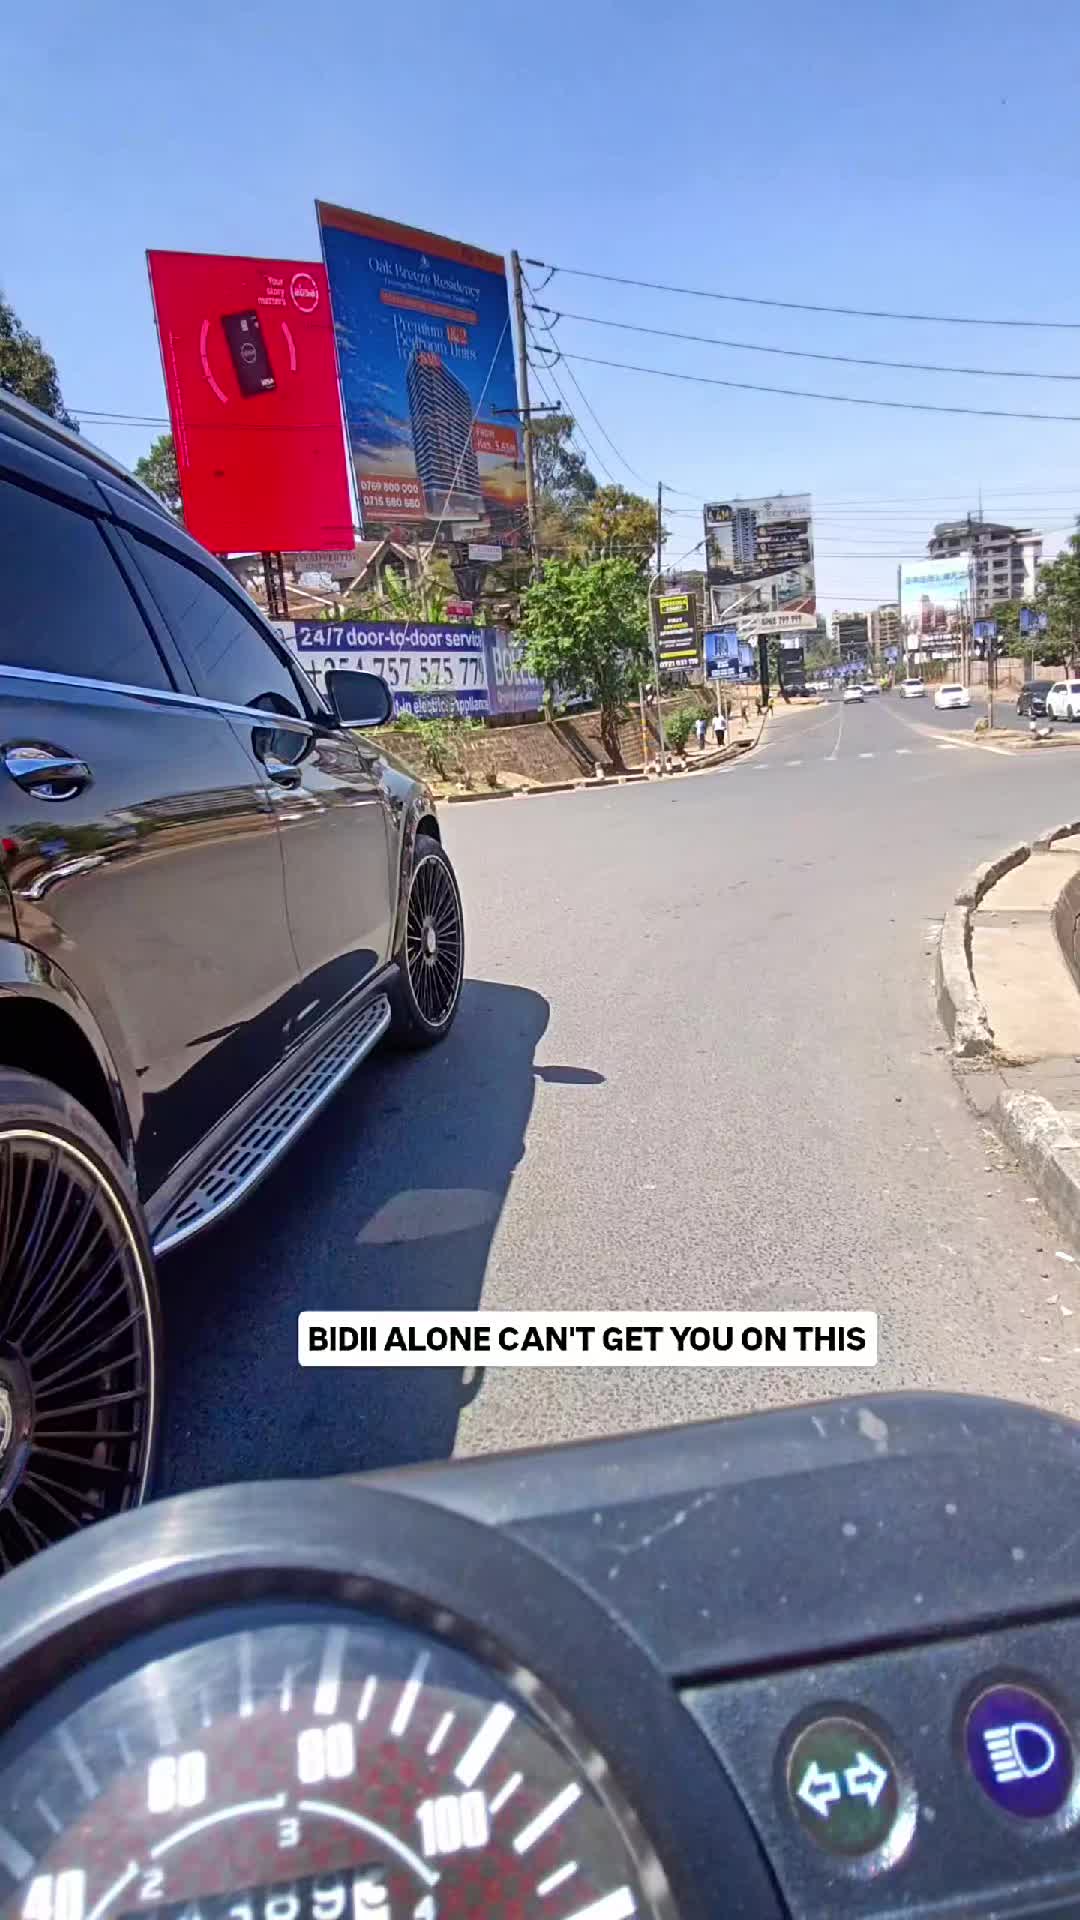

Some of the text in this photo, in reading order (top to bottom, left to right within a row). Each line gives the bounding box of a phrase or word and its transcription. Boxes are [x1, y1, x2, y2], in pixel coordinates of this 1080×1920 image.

[300, 627, 344, 646] 24/7
[346, 626, 443, 647] door-to-door
[373, 657, 411, 686] 757
[420, 657, 453, 685] 575
[297, 1721, 356, 1785] 80
[278, 1818, 300, 1849] 3
[416, 1791, 489, 1857] 100
[21, 1868, 87, 1920] 40
[140, 1867, 165, 1900] 2
